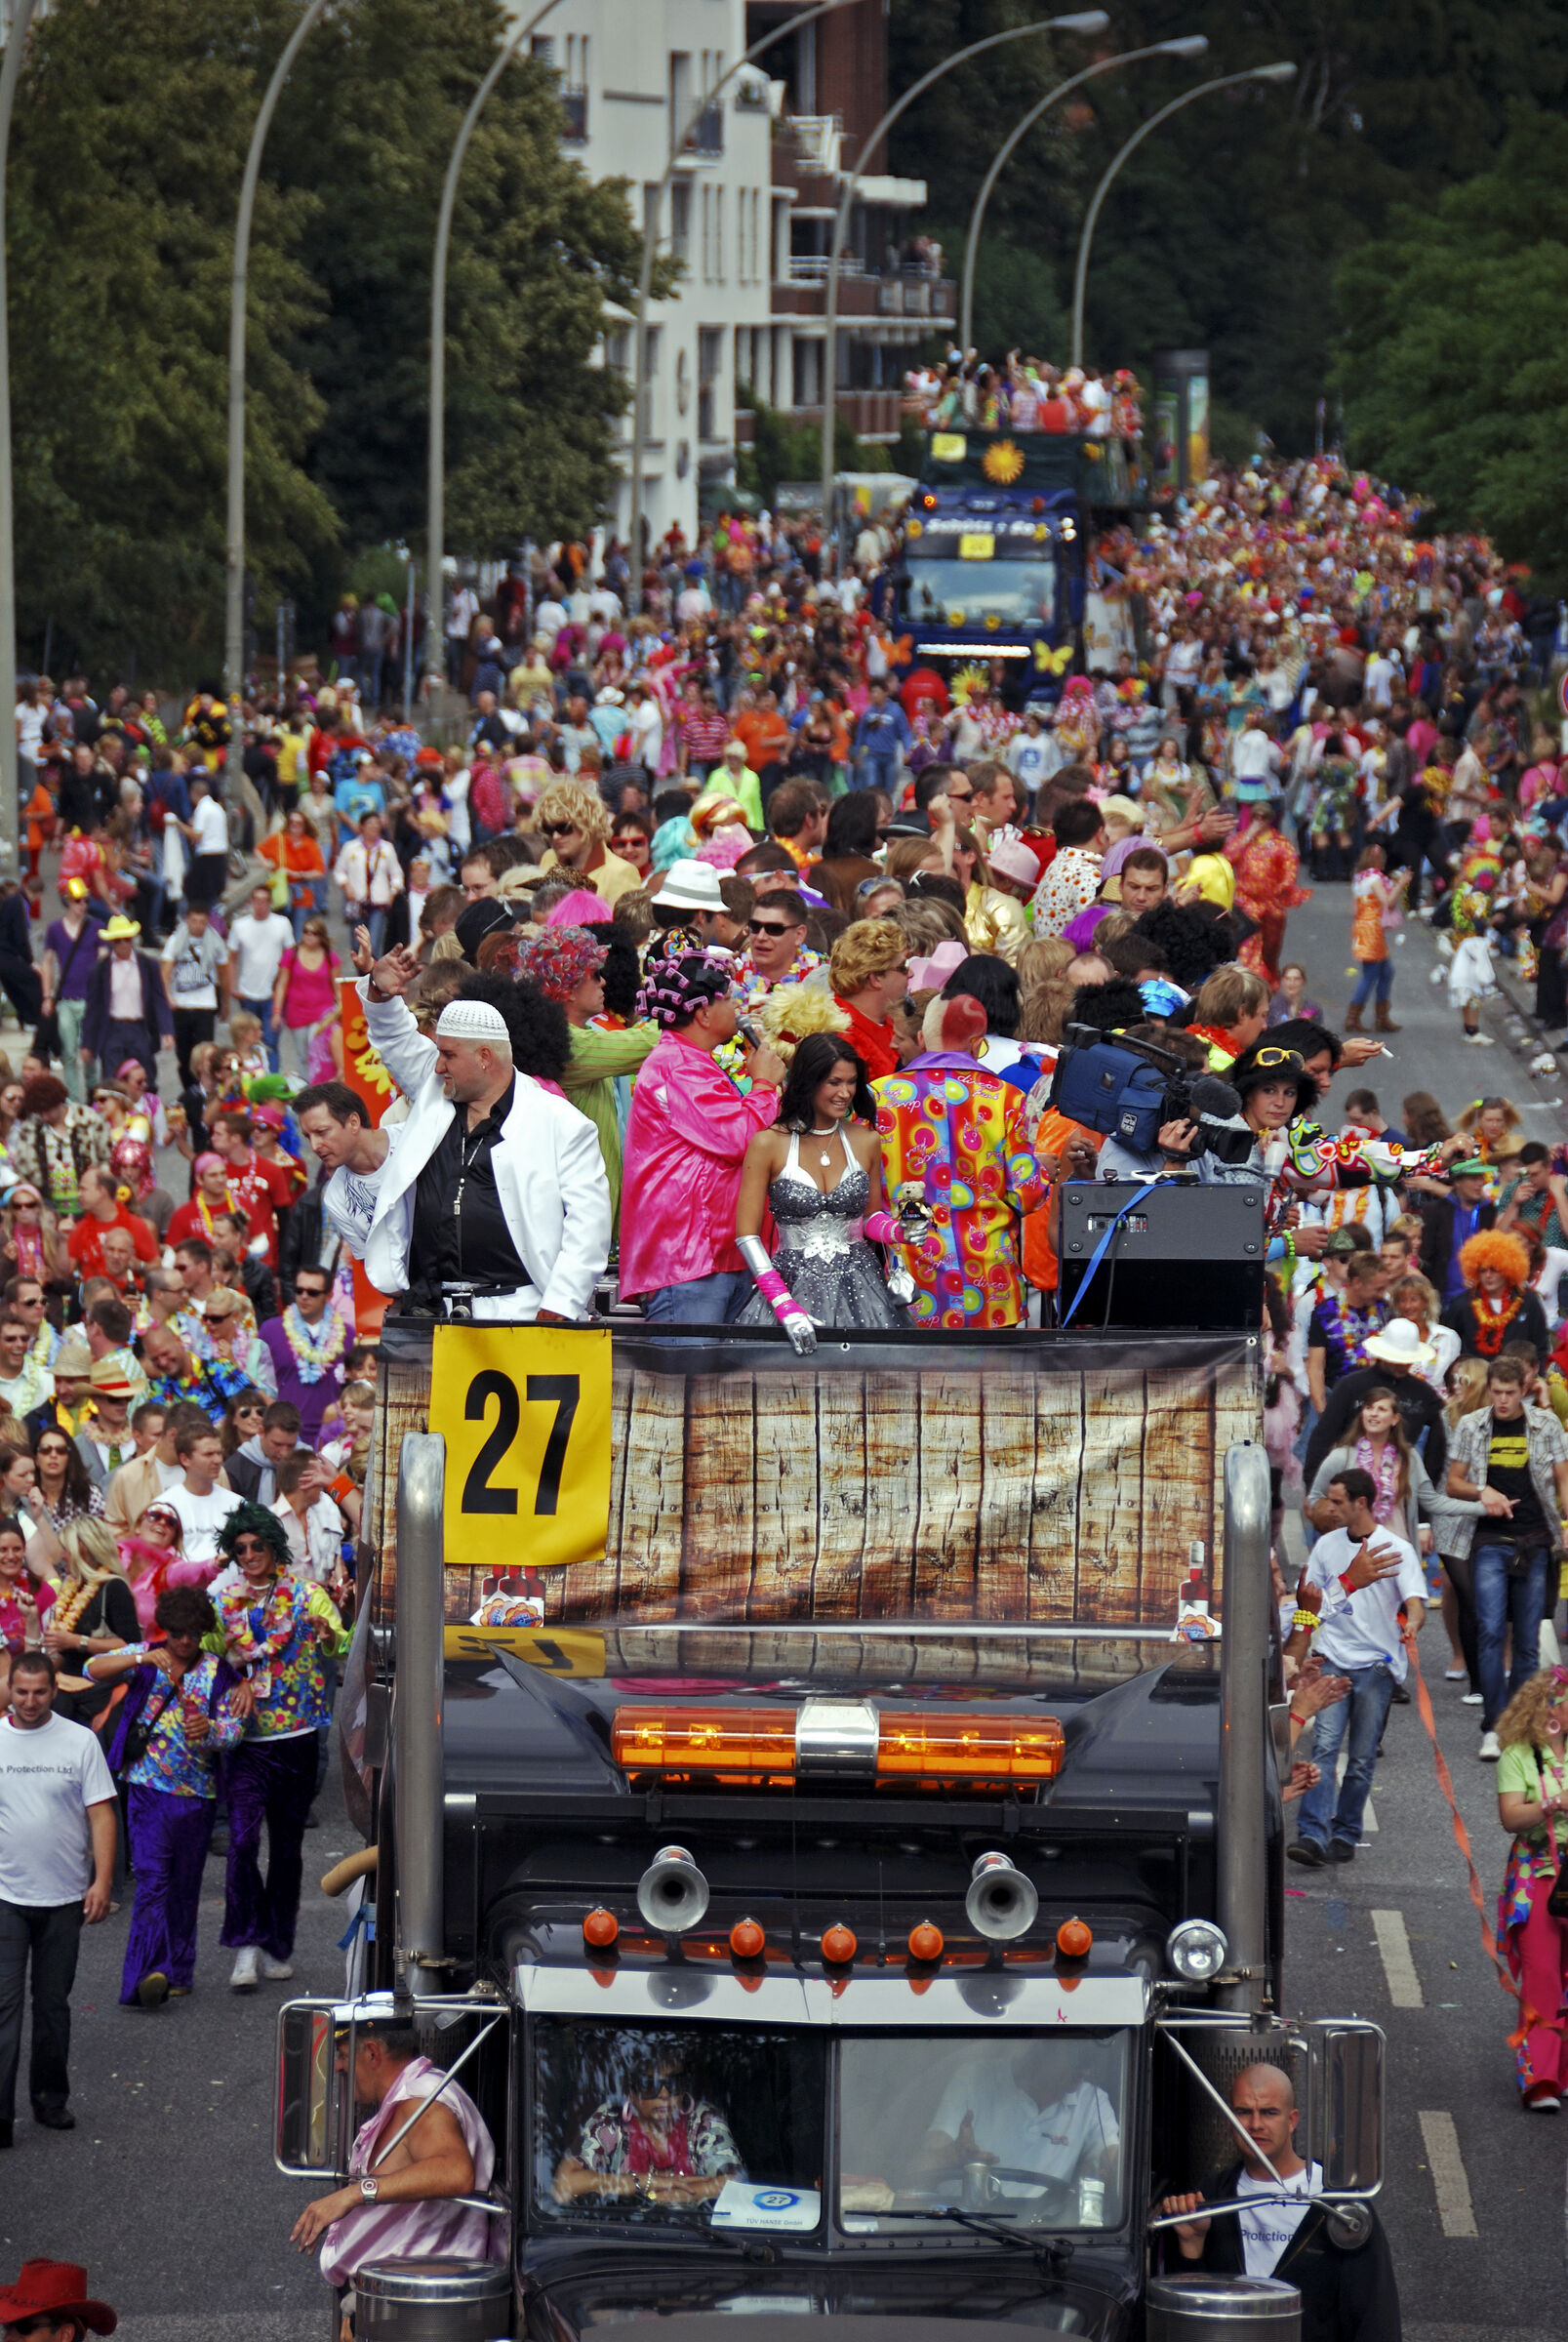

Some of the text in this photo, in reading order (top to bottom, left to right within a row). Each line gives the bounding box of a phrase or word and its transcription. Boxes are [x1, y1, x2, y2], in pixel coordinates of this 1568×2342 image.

[957, 1074, 998, 1092] disco
[973, 1274, 1007, 1288] disco
[462, 1369, 581, 1515] 27
[767, 2196, 787, 2204] 27
